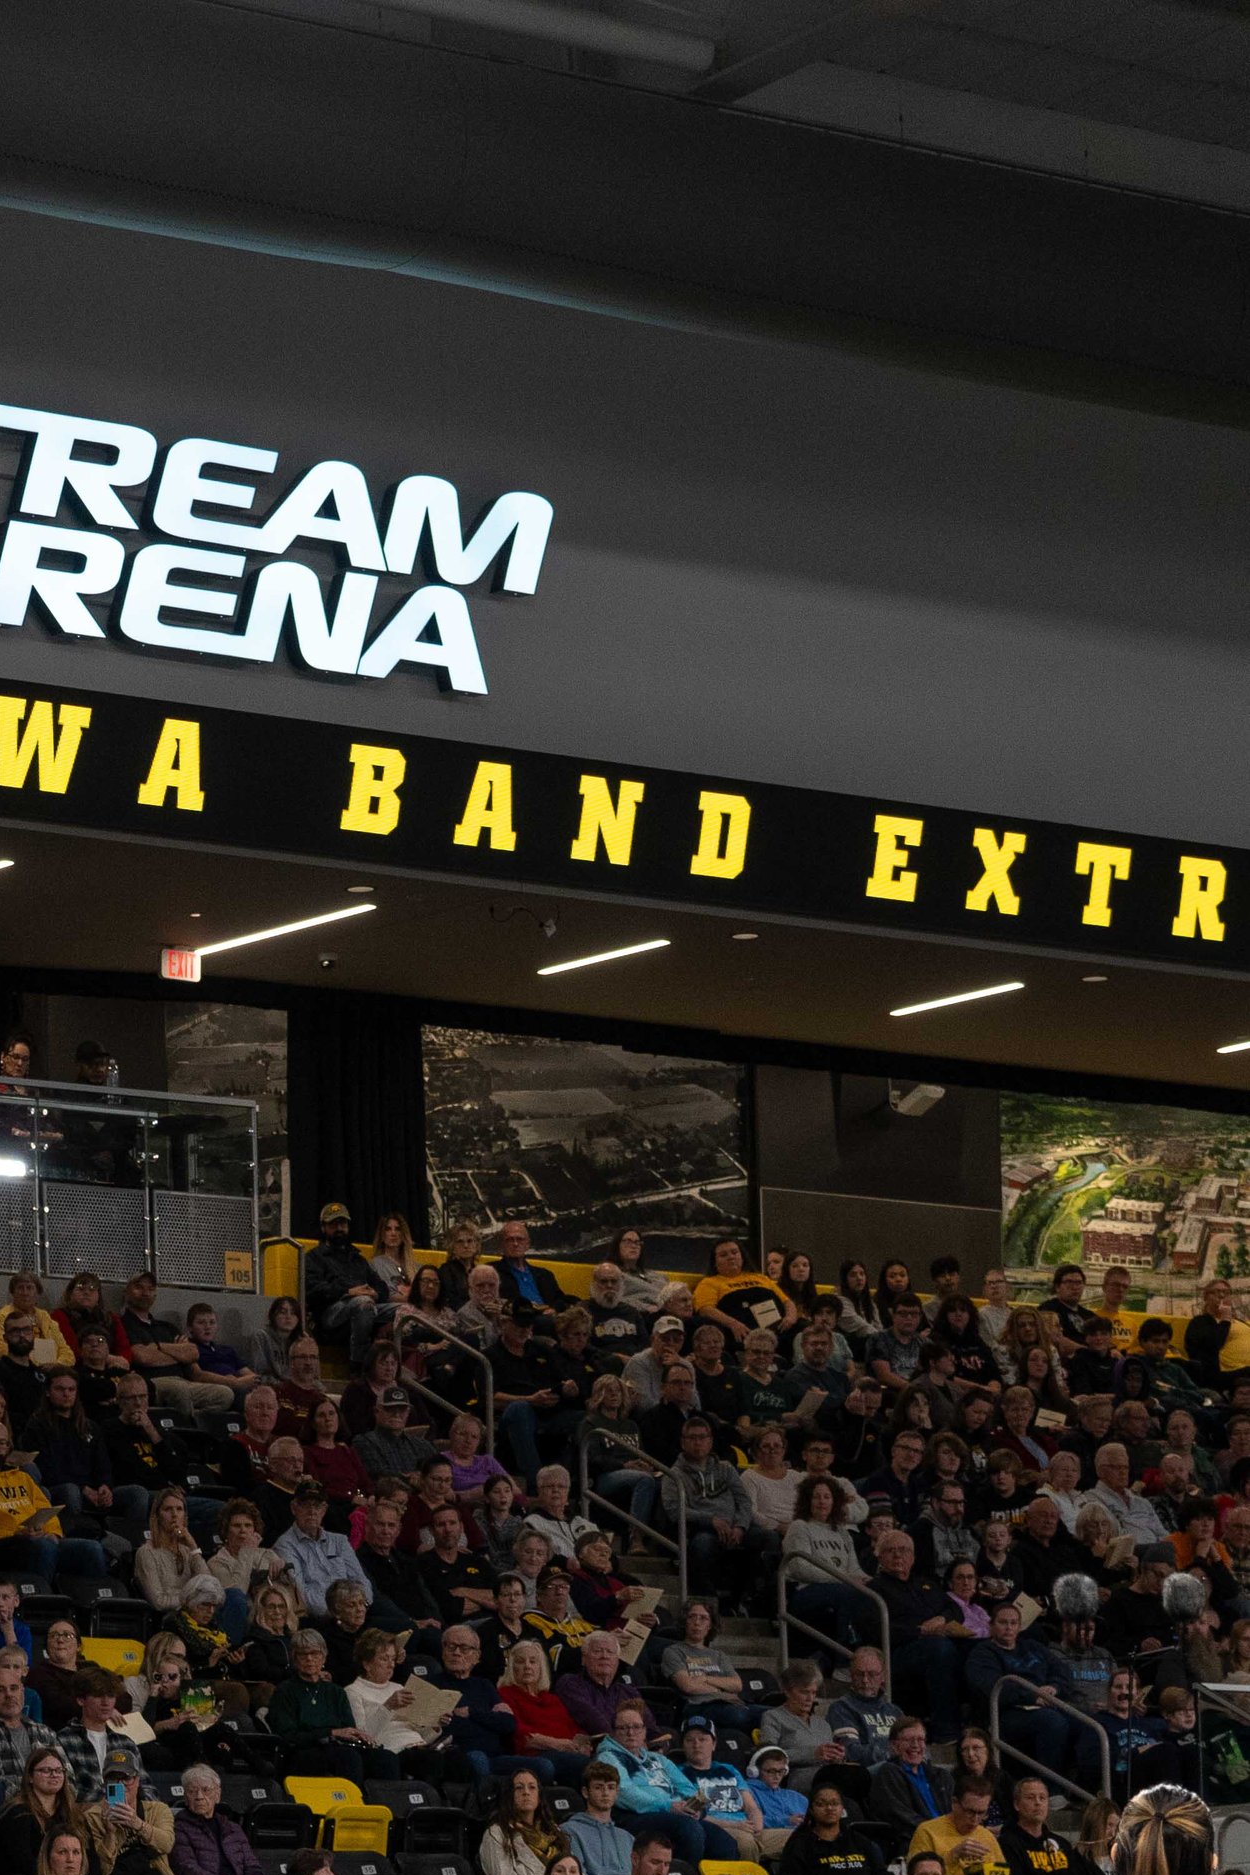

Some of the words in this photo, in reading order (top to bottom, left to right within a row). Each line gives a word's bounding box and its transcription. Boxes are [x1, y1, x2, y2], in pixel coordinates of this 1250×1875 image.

[341, 743, 752, 880] BAND
[866, 814, 1227, 942] EXTR
[167, 949, 196, 979] EXIT
[230, 1269, 250, 1283] 105
